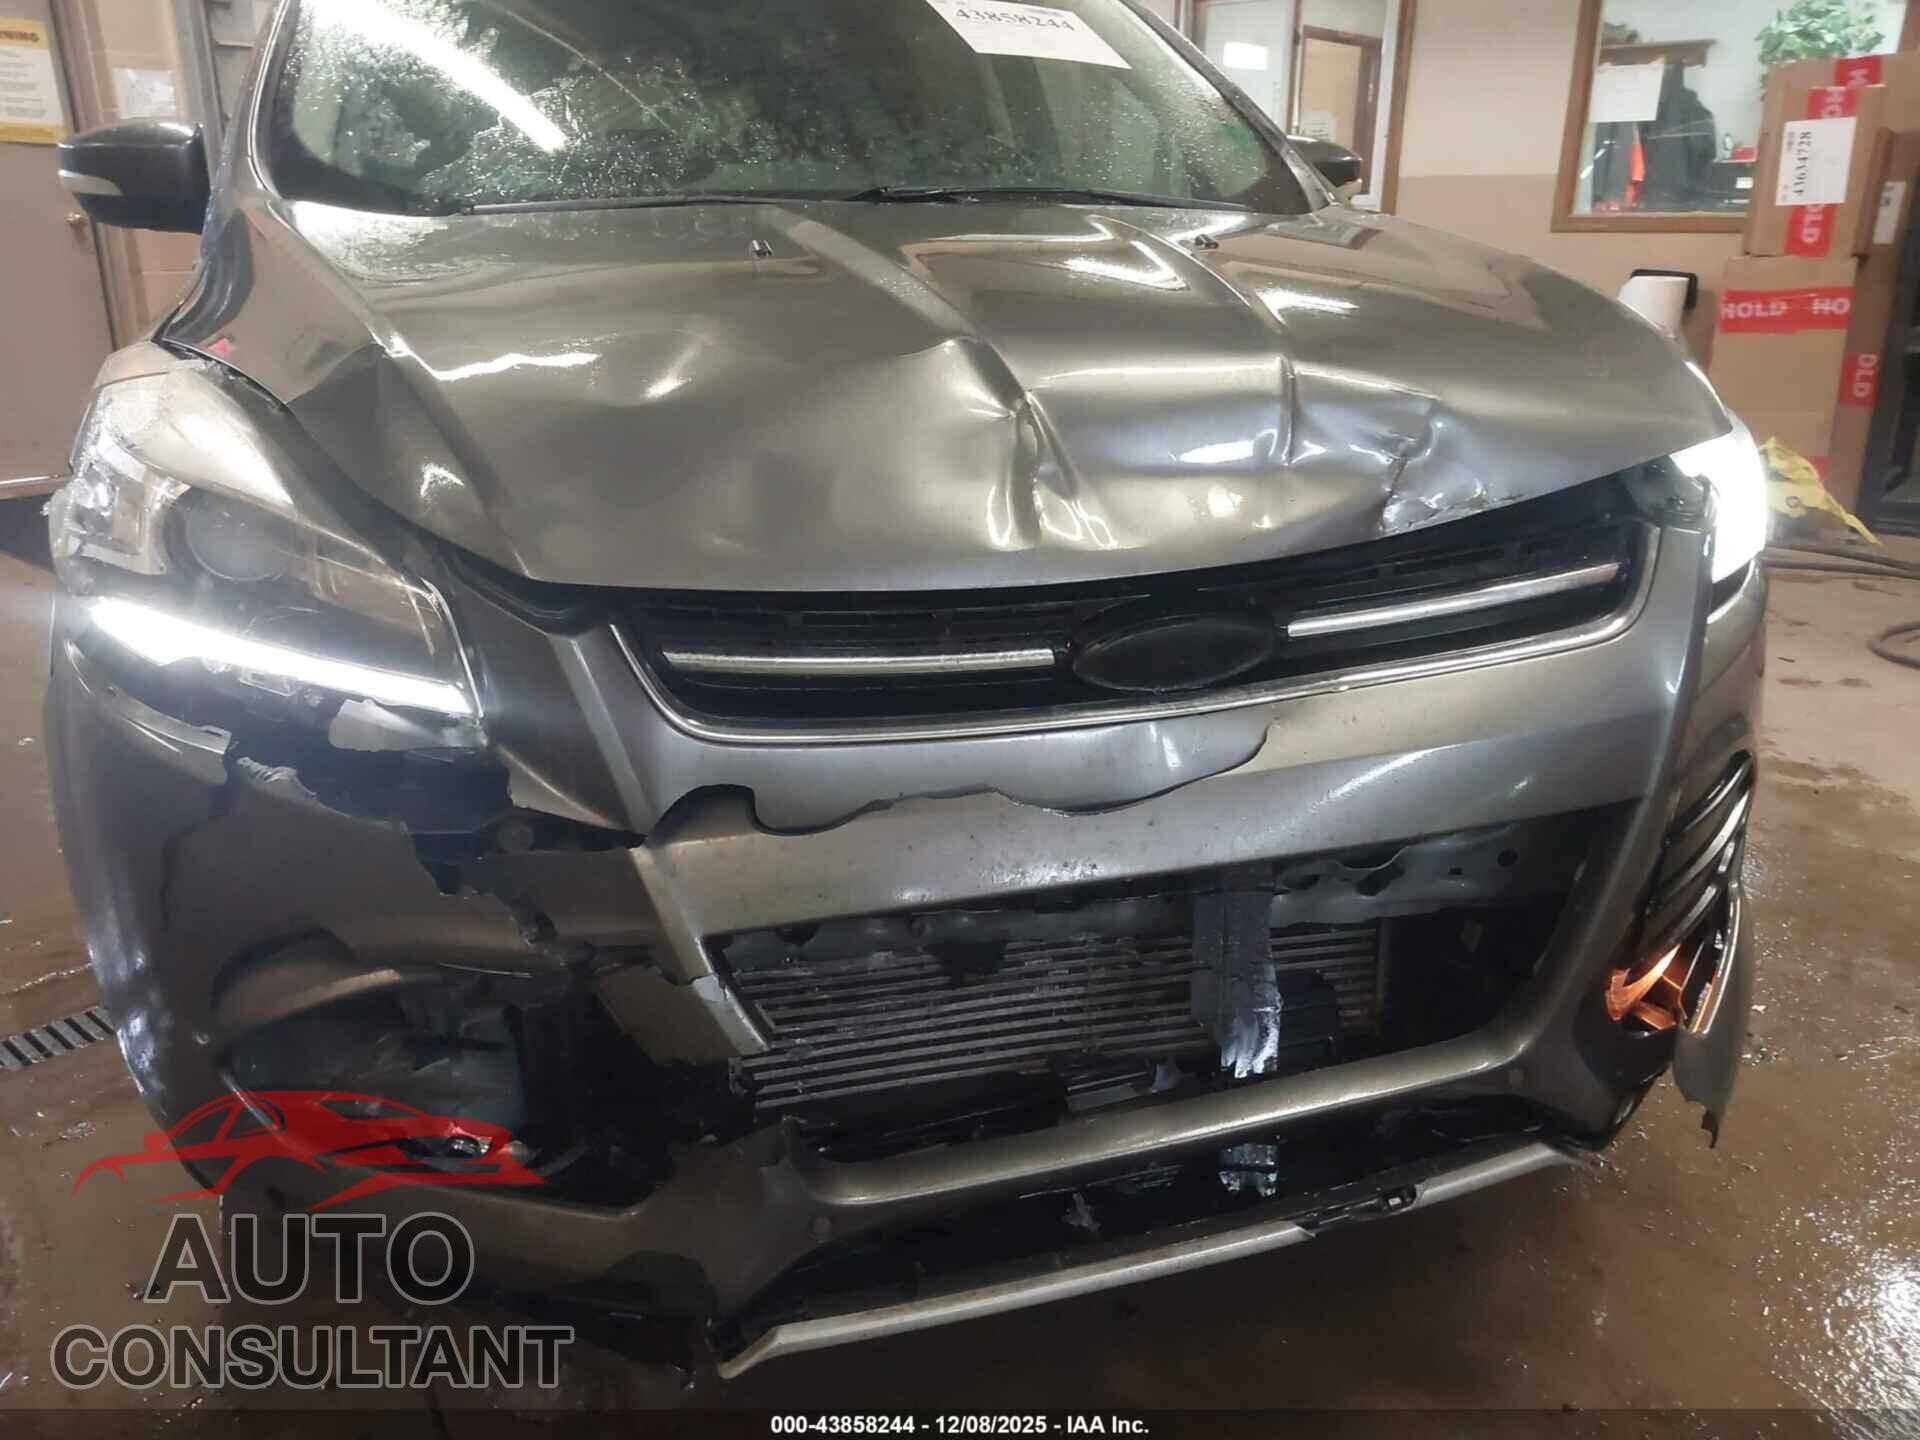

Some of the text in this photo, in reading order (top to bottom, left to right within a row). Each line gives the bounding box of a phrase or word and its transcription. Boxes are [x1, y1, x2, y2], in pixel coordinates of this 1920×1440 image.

[956, 8, 1075, 31] 43858244
[1720, 297, 1851, 319] HOLD HO
[1853, 353, 1878, 398] OLD
